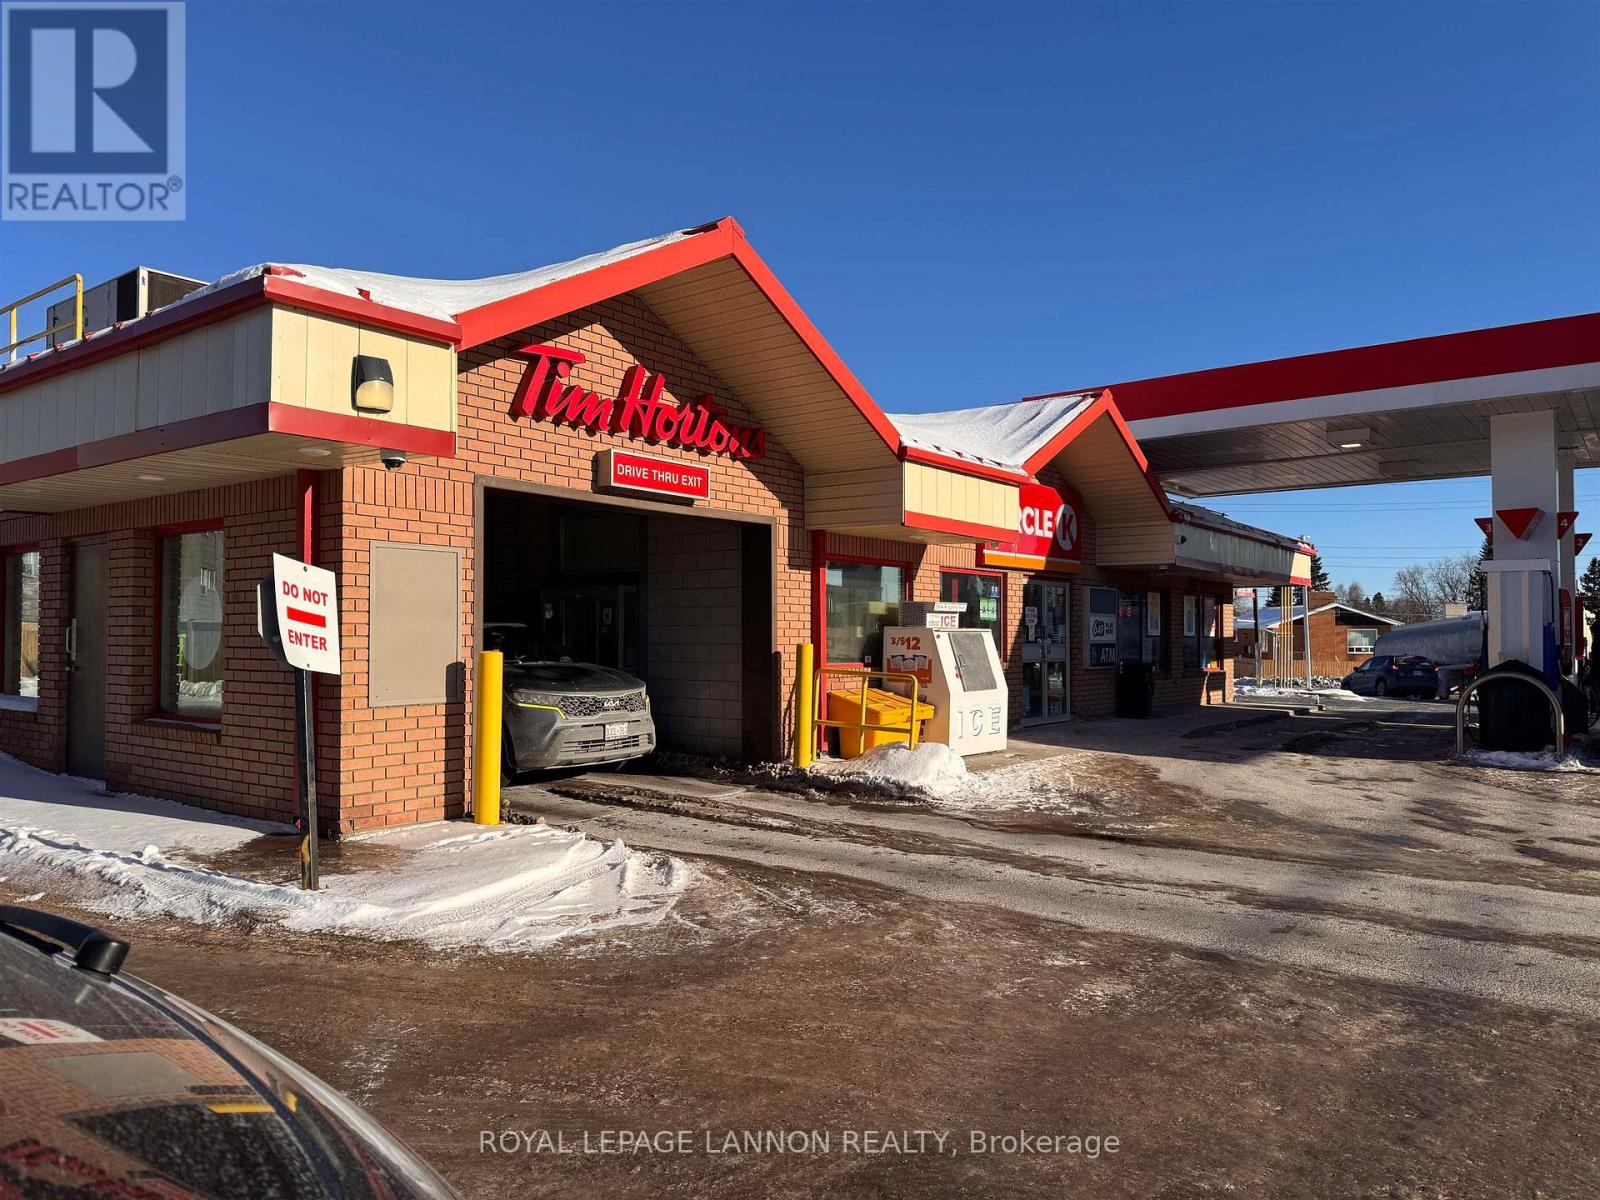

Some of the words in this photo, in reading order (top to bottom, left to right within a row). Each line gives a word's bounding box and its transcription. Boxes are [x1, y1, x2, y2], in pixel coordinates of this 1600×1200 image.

[510, 344, 611, 434] Tim
[617, 463, 649, 480] DRIVE
[651, 469, 679, 485] THRU
[681, 474, 702, 488] EXIT
[1019, 505, 1053, 538] CLE
[1485, 524, 1492, 532] 3
[1561, 519, 1569, 528] 4
[282, 580, 299, 599] DO
[303, 587, 328, 607] NOT
[940, 615, 956, 627] ICE
[287, 628, 328, 651] ENTER
[890, 636, 921, 650] 3/$12
[1100, 647, 1116, 663] ATM
[956, 704, 1001, 739] ICE
